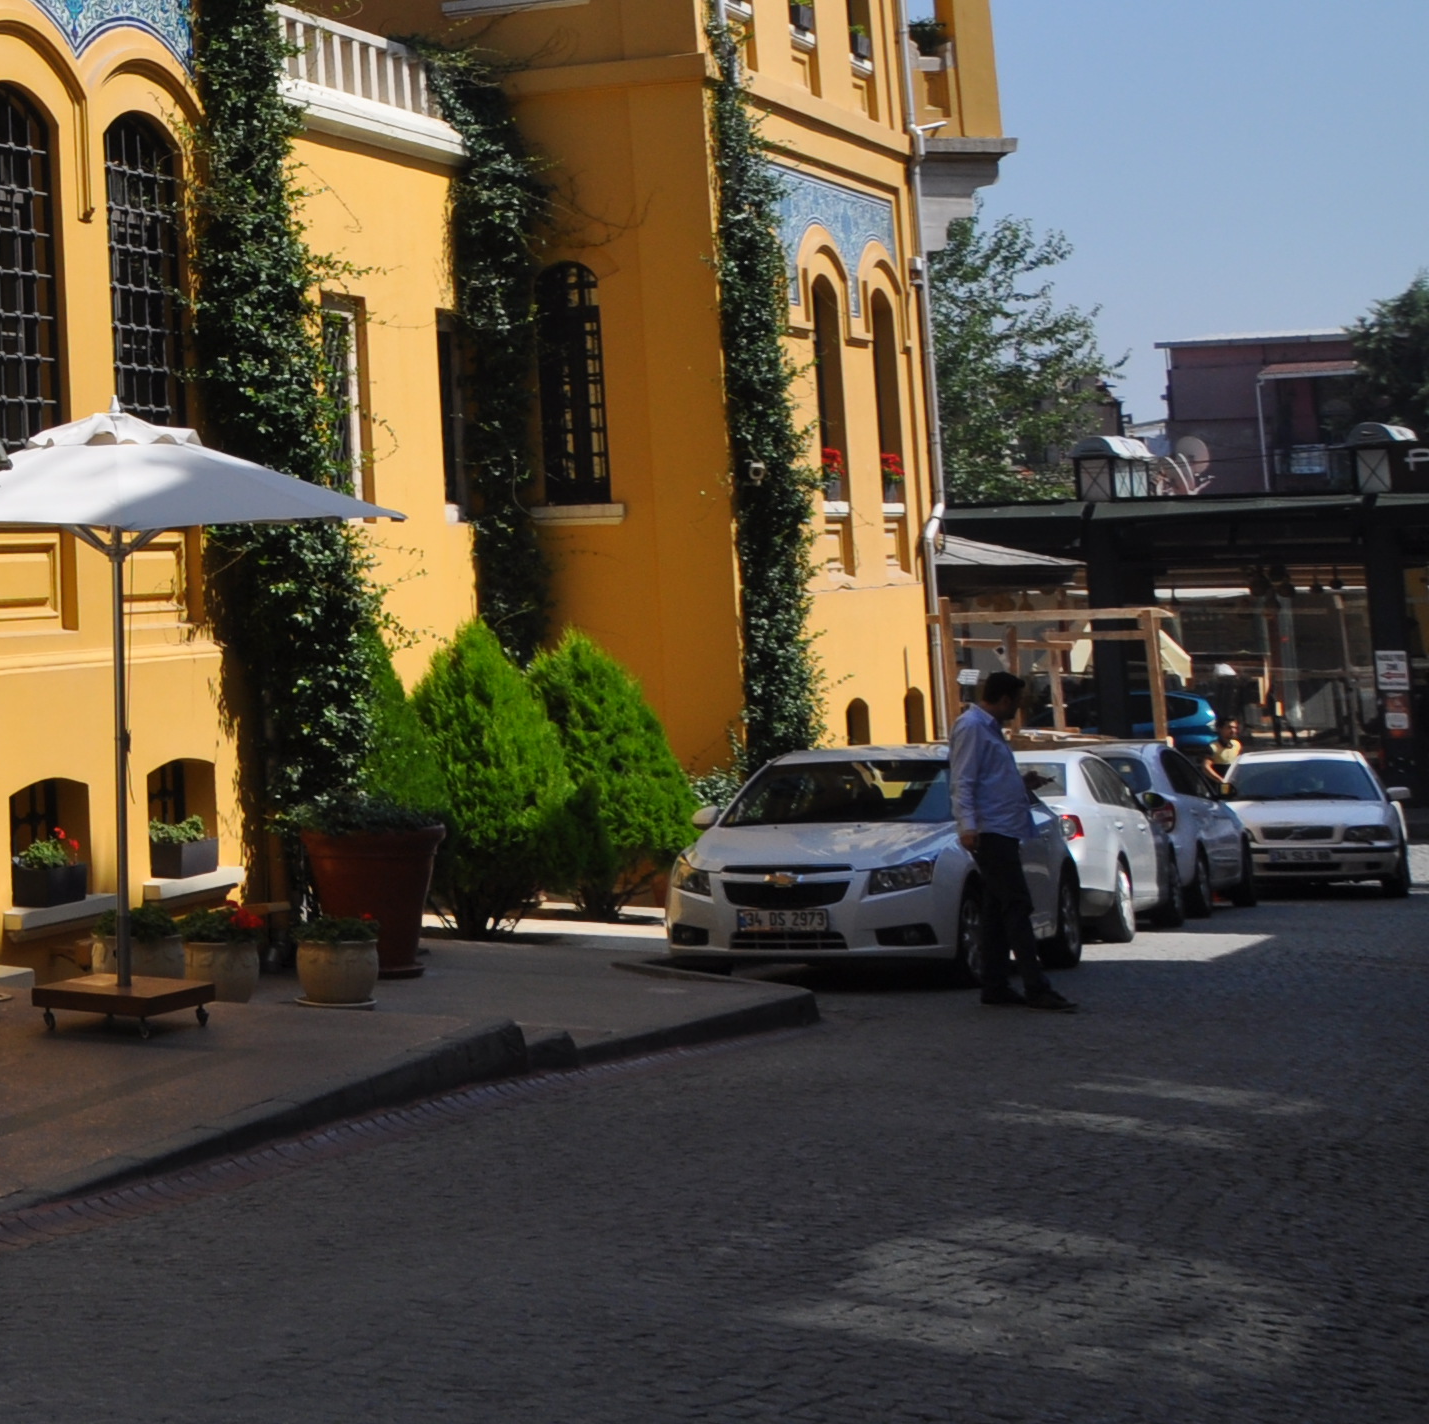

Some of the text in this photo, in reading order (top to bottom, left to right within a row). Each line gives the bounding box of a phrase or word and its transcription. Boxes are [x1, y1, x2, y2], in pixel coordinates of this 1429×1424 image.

[748, 912, 825, 926] 34 DS 2973
